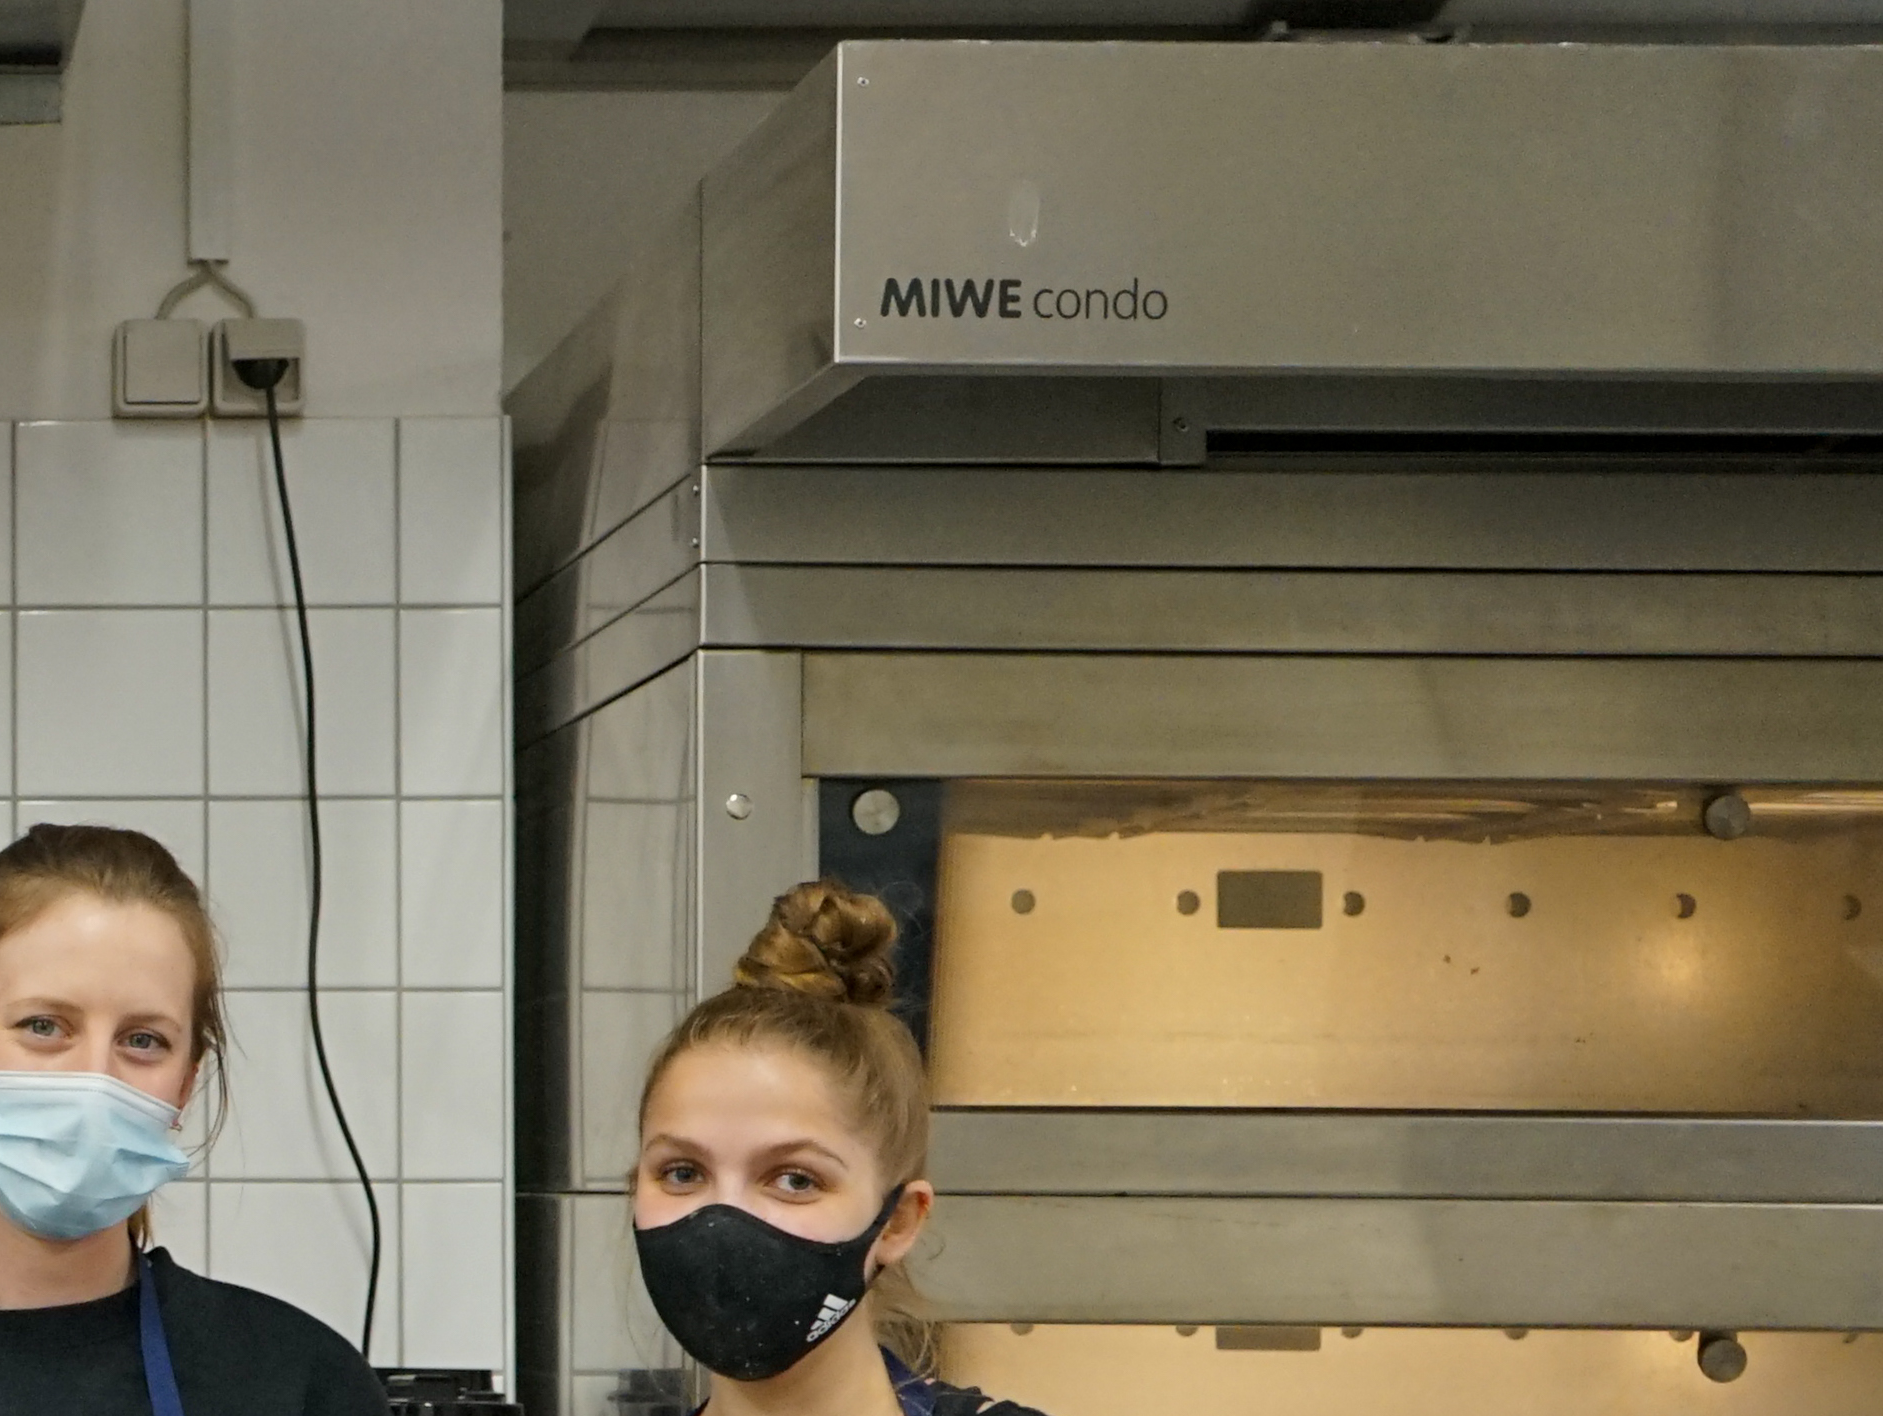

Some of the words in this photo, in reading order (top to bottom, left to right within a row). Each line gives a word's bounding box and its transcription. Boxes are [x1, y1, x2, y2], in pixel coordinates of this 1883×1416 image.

[880, 277, 1022, 318] MIWE
[1033, 277, 1168, 320] condo
[806, 1298, 856, 1342] adidas
